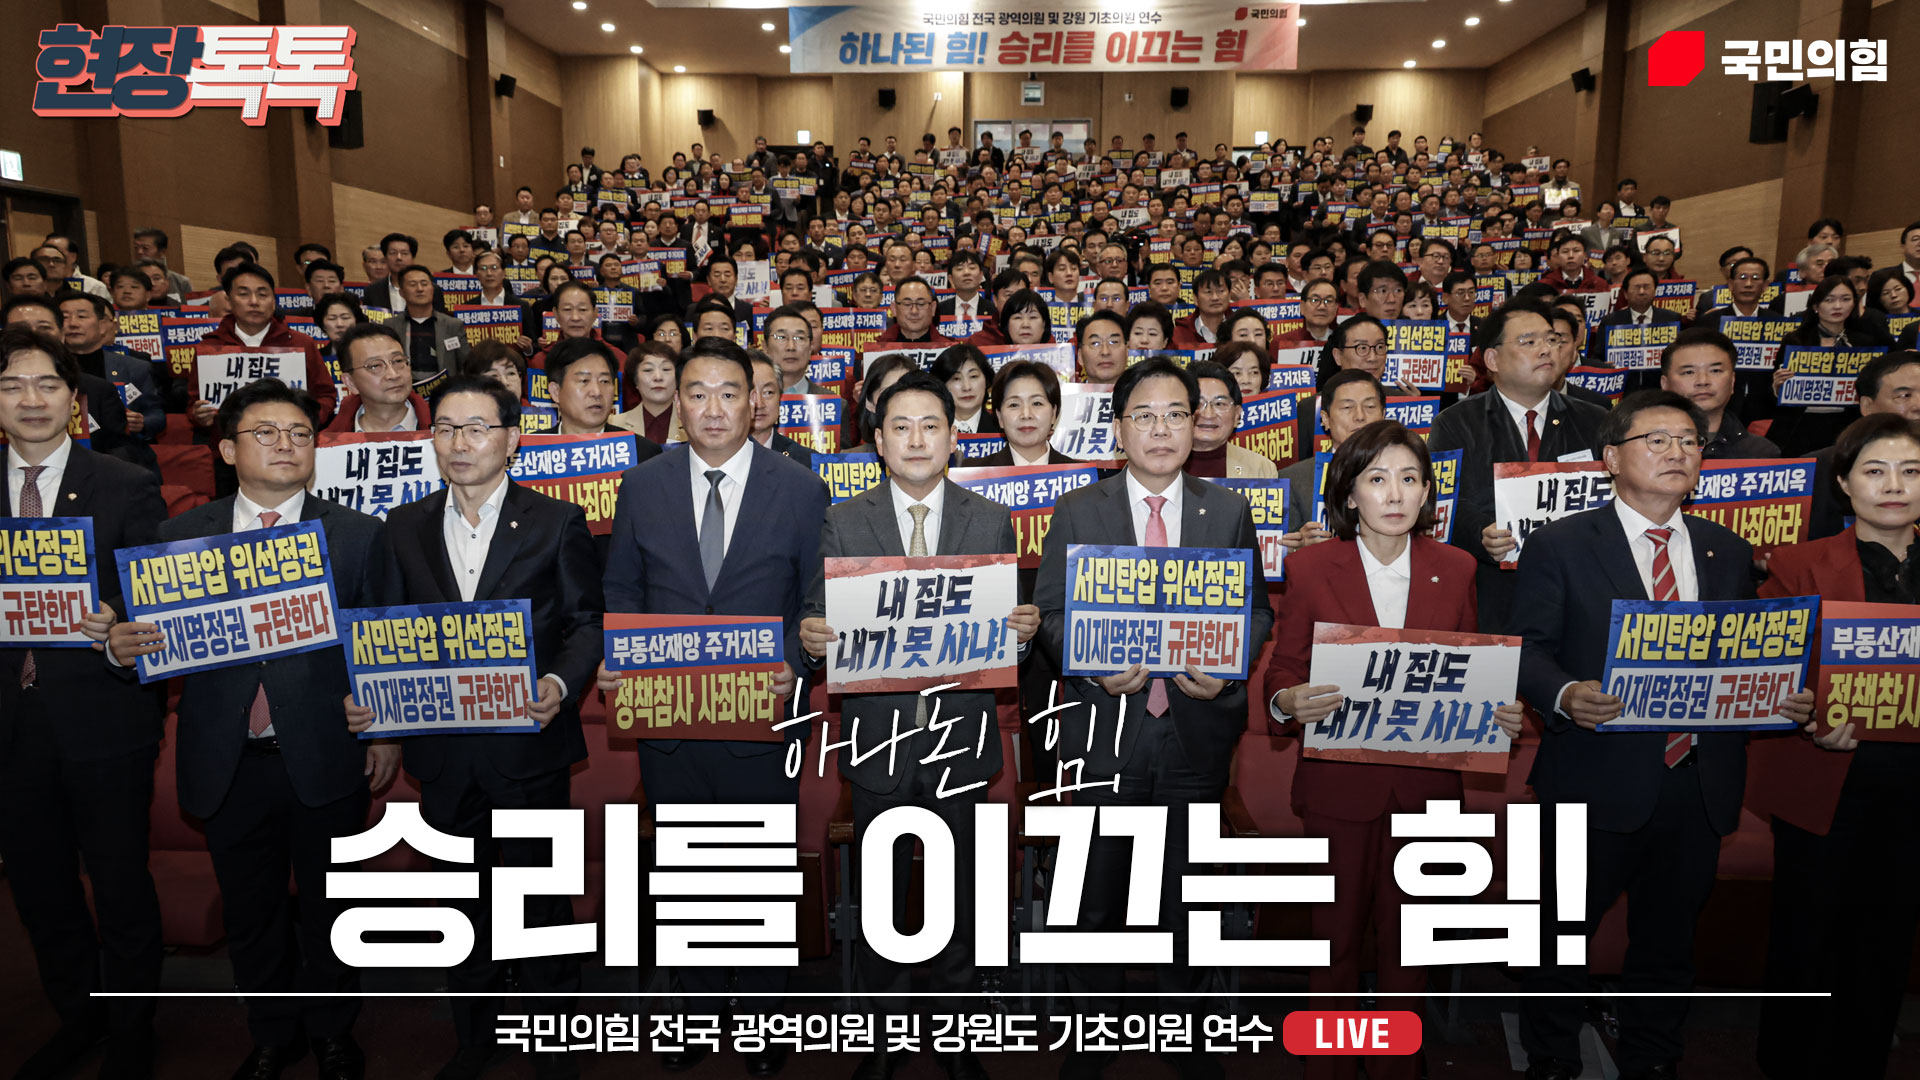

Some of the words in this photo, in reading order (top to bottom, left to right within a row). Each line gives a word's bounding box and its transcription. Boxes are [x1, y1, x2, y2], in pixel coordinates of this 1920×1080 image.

[923, 12, 968, 25] 국민의힘
[972, 12, 994, 25] 전국
[997, 12, 1046, 25] 광역의원
[1049, 12, 1059, 25] 및
[1063, 12, 1085, 25] 강원
[1088, 12, 1134, 25] 기초의원
[1137, 12, 1162, 25] 연수
[1251, 9, 1288, 20] 국민의힘
[839, 31, 934, 66] 하나된
[946, 31, 987, 66] 힘!
[998, 31, 1095, 65] 승리를
[1106, 30, 1203, 65] 이끄는
[1214, 29, 1248, 64] 힘
[119, 314, 160, 334] 위선정권
[1399, 325, 1446, 352] 위선정권
[1608, 329, 1642, 347] 서민탄압
[1643, 325, 1677, 345] 위선정권
[1723, 320, 1763, 341] 서민탄압
[227, 356, 244, 378] 내
[248, 356, 280, 378] 집도
[1273, 370, 1311, 388] 주거지옥
[1401, 357, 1441, 384] 규탄한다
[1787, 351, 1835, 375] 서민탄압
[1586, 373, 1625, 392] 주거지옥
[1784, 378, 1834, 402] 이재명정권
[791, 402, 836, 424] 주거지옥
[1247, 398, 1292, 427] 주거지옥
[345, 446, 370, 481] 내
[375, 445, 425, 480] 집도
[508, 448, 567, 477] 동산재앙
[570, 441, 631, 472] 주거지옥
[1537, 476, 1558, 513] 내
[1563, 475, 1617, 511] 집도
[1740, 467, 1806, 497] 주거지옥
[129, 547, 230, 608] 서민탄압
[229, 531, 325, 591] 위선정권
[1073, 556, 1159, 605] 서민탄압
[1162, 559, 1246, 607] 위선정권
[3, 588, 88, 637] 규탄한다
[876, 575, 910, 622] 내
[914, 573, 974, 620] 집도
[150, 605, 251, 668] 이재명정권
[250, 590, 331, 650] 규탄한다
[352, 615, 440, 666] 서민탄압
[441, 611, 528, 661] 위선정권
[613, 631, 701, 666] 부동산재앙
[705, 628, 776, 660] 주거지옥
[835, 626, 897, 673] 내가
[901, 625, 934, 669] 못
[936, 616, 1009, 667] 사냐!
[1073, 617, 1163, 665] 이재명정권
[1167, 619, 1240, 668] 규탄한다
[1614, 612, 1718, 661] 서민탄압
[1717, 608, 1811, 660] 위선정권
[1361, 648, 1402, 694] 내
[1403, 648, 1471, 694] 집도
[362, 675, 455, 725] 이재명정권
[457, 672, 529, 722] 규탄한다
[614, 674, 694, 730] 정책참사
[698, 670, 777, 725] 사죄하라
[1612, 674, 1715, 720] 이재명정권
[1714, 671, 1795, 720] 규탄한다
[1313, 697, 1381, 742] 내가
[1383, 698, 1420, 742] 못
[1420, 699, 1506, 746] 사냐!
